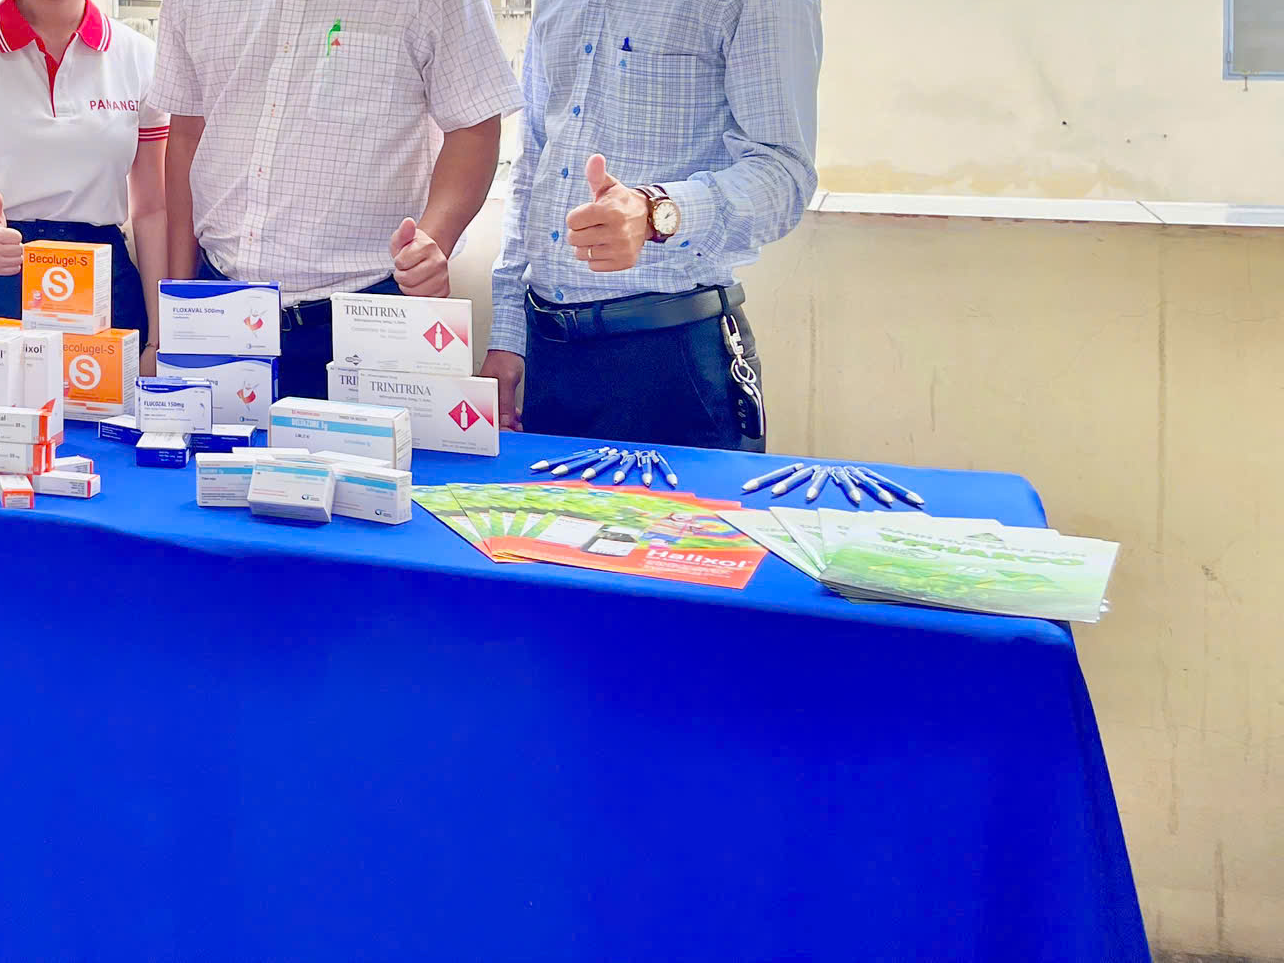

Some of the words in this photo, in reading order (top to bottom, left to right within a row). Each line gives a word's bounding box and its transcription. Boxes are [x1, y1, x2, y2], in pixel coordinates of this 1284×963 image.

[29, 253, 88, 268] Becolugel-S
[48, 270, 68, 298] S
[344, 305, 407, 318] TRINITRINA
[25, 344, 43, 354] ixol
[63, 343, 115, 356] ecolugel-S
[75, 358, 95, 386] S
[369, 381, 432, 396] TRINITRINA
[646, 548, 746, 568] Halixol
